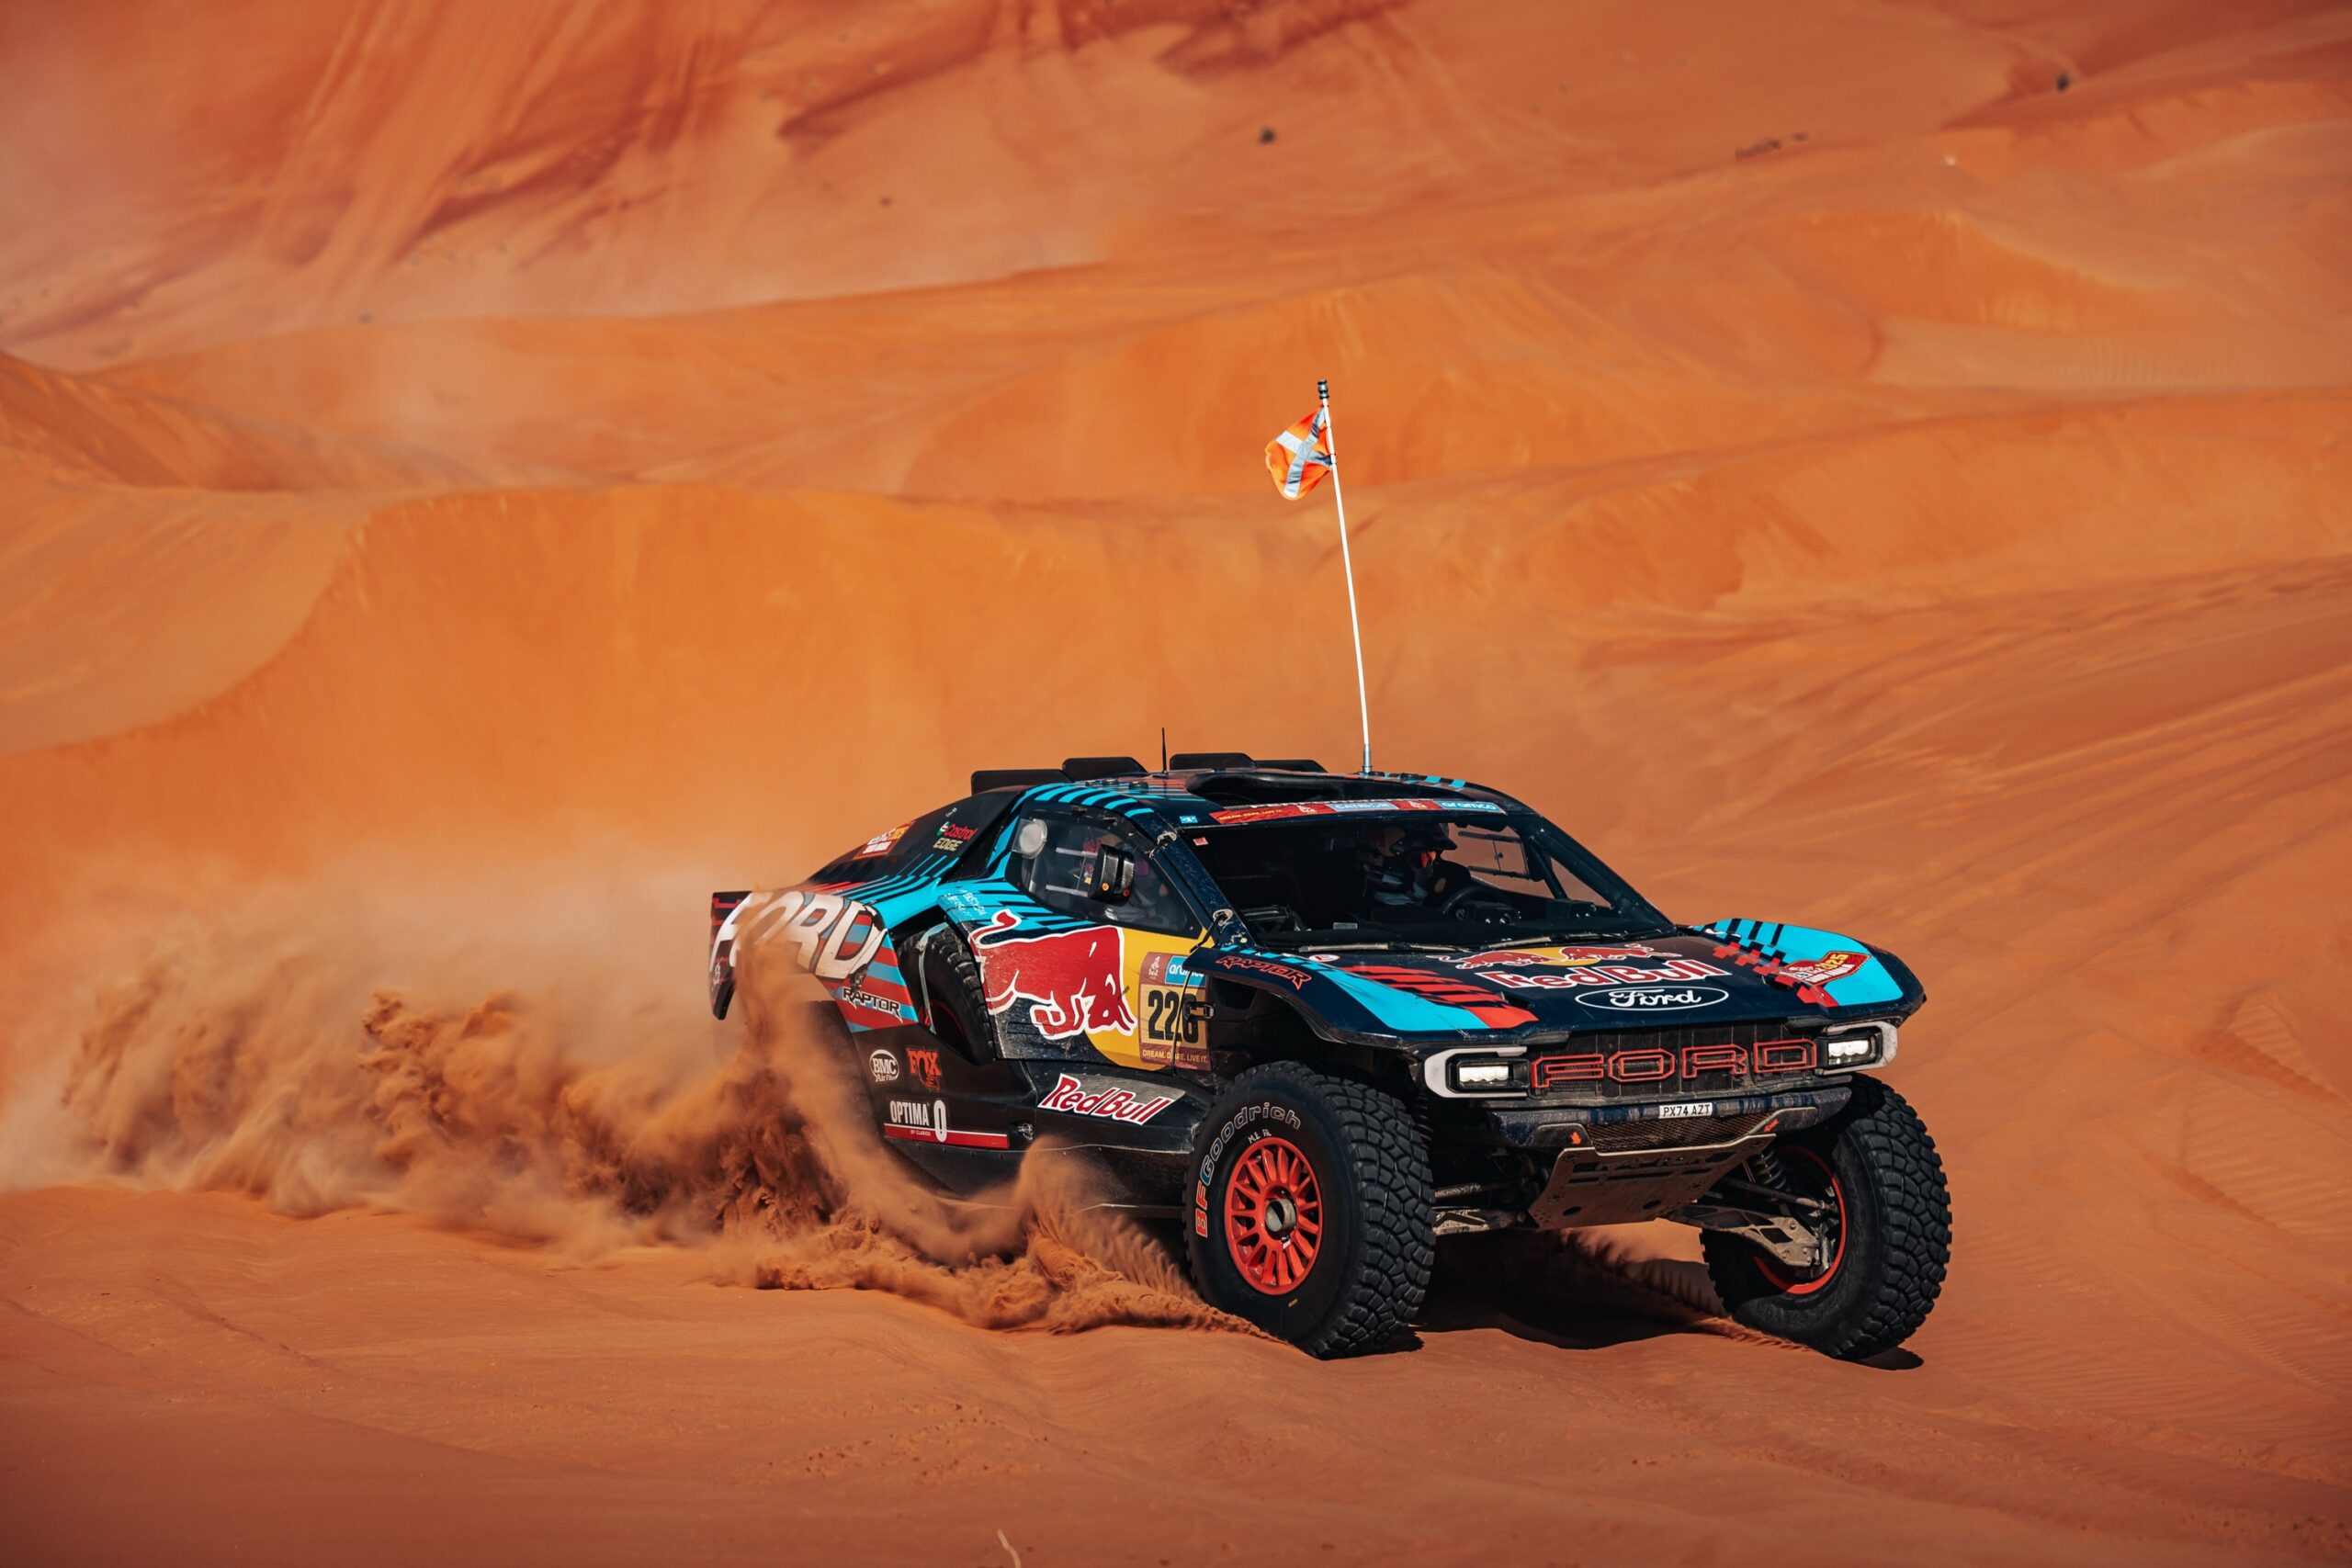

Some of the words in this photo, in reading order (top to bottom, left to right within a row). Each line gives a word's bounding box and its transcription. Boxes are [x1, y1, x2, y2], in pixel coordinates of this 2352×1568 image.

[1441, 802, 1497, 810] aramco
[944, 823, 978, 840] Castrol
[933, 837, 963, 852] EDGE
[1169, 964, 1204, 977] ara
[1216, 955, 1312, 990] RAPTOR
[842, 986, 903, 1023] RAPTOR
[1608, 988, 1702, 1007] Ford
[1148, 989, 1199, 1043] 226
[1142, 1049, 1166, 1058] DREAM.
[1166, 1052, 1186, 1061] DRE.
[1531, 1038, 1817, 1089] FORD
[872, 1057, 897, 1075] BMC
[908, 1049, 941, 1088] FOX
[889, 1100, 930, 1126] OPTIMA
[1662, 1105, 1689, 1117] PX74
[1691, 1104, 1711, 1115] AZT
[1195, 1101, 1301, 1239] BFGoodrich
